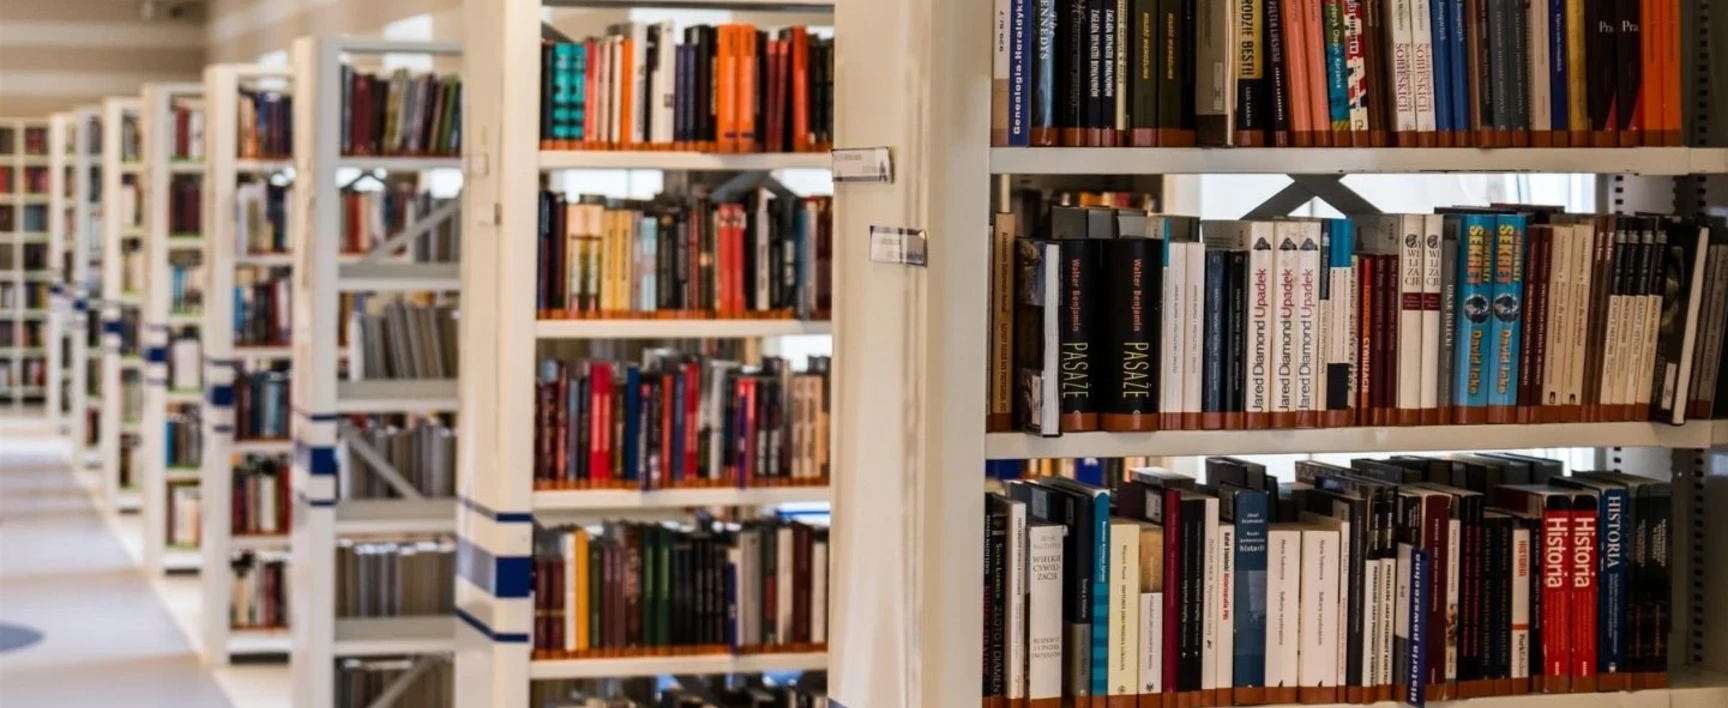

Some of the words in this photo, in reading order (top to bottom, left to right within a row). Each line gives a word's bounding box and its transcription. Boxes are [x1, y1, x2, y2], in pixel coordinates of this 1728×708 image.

[1040, 0, 1050, 60] ENNEDYS
[1331, 3, 1341, 27] yderyk
[1241, 41, 1254, 76] BESTII
[1333, 29, 1343, 56] Chopin
[1396, 43, 1408, 113] SOBIESKICH
[1415, 43, 1427, 113] SOBIESKICH
[1071, 259, 1081, 287] Walter
[1132, 259, 1142, 287] Walter
[1467, 225, 1484, 285] SEKRET
[1497, 225, 1514, 285] SEKRET
[1069, 290, 1081, 332] Benjamin
[1130, 290, 1142, 332] Benjamin
[1254, 268, 1269, 318] Upadek
[1280, 268, 1295, 318] Upadek
[1301, 268, 1316, 318] Upadek
[1062, 342, 1091, 398] PASAŻE
[1123, 342, 1152, 398] PASAŻE
[1252, 320, 1266, 376] Diamond
[1278, 320, 1292, 376] Diamond
[1299, 320, 1313, 376] Diamond
[1361, 337, 1370, 393] CYWILIZACJE
[1470, 329, 1482, 364] David
[1500, 329, 1512, 363] David
[1252, 378, 1264, 412] Jared
[1278, 378, 1290, 412] Jared
[1299, 378, 1311, 412] Jared
[1547, 517, 1569, 588] Historia
[1574, 517, 1596, 588] Historia
[1607, 495, 1621, 568] HISTORIA
[1518, 540, 1528, 577] HISTORIA
[1412, 553, 1421, 641] powszechna
[993, 650, 1001, 693] DIAMEN
[1410, 645, 1421, 702] Historia
